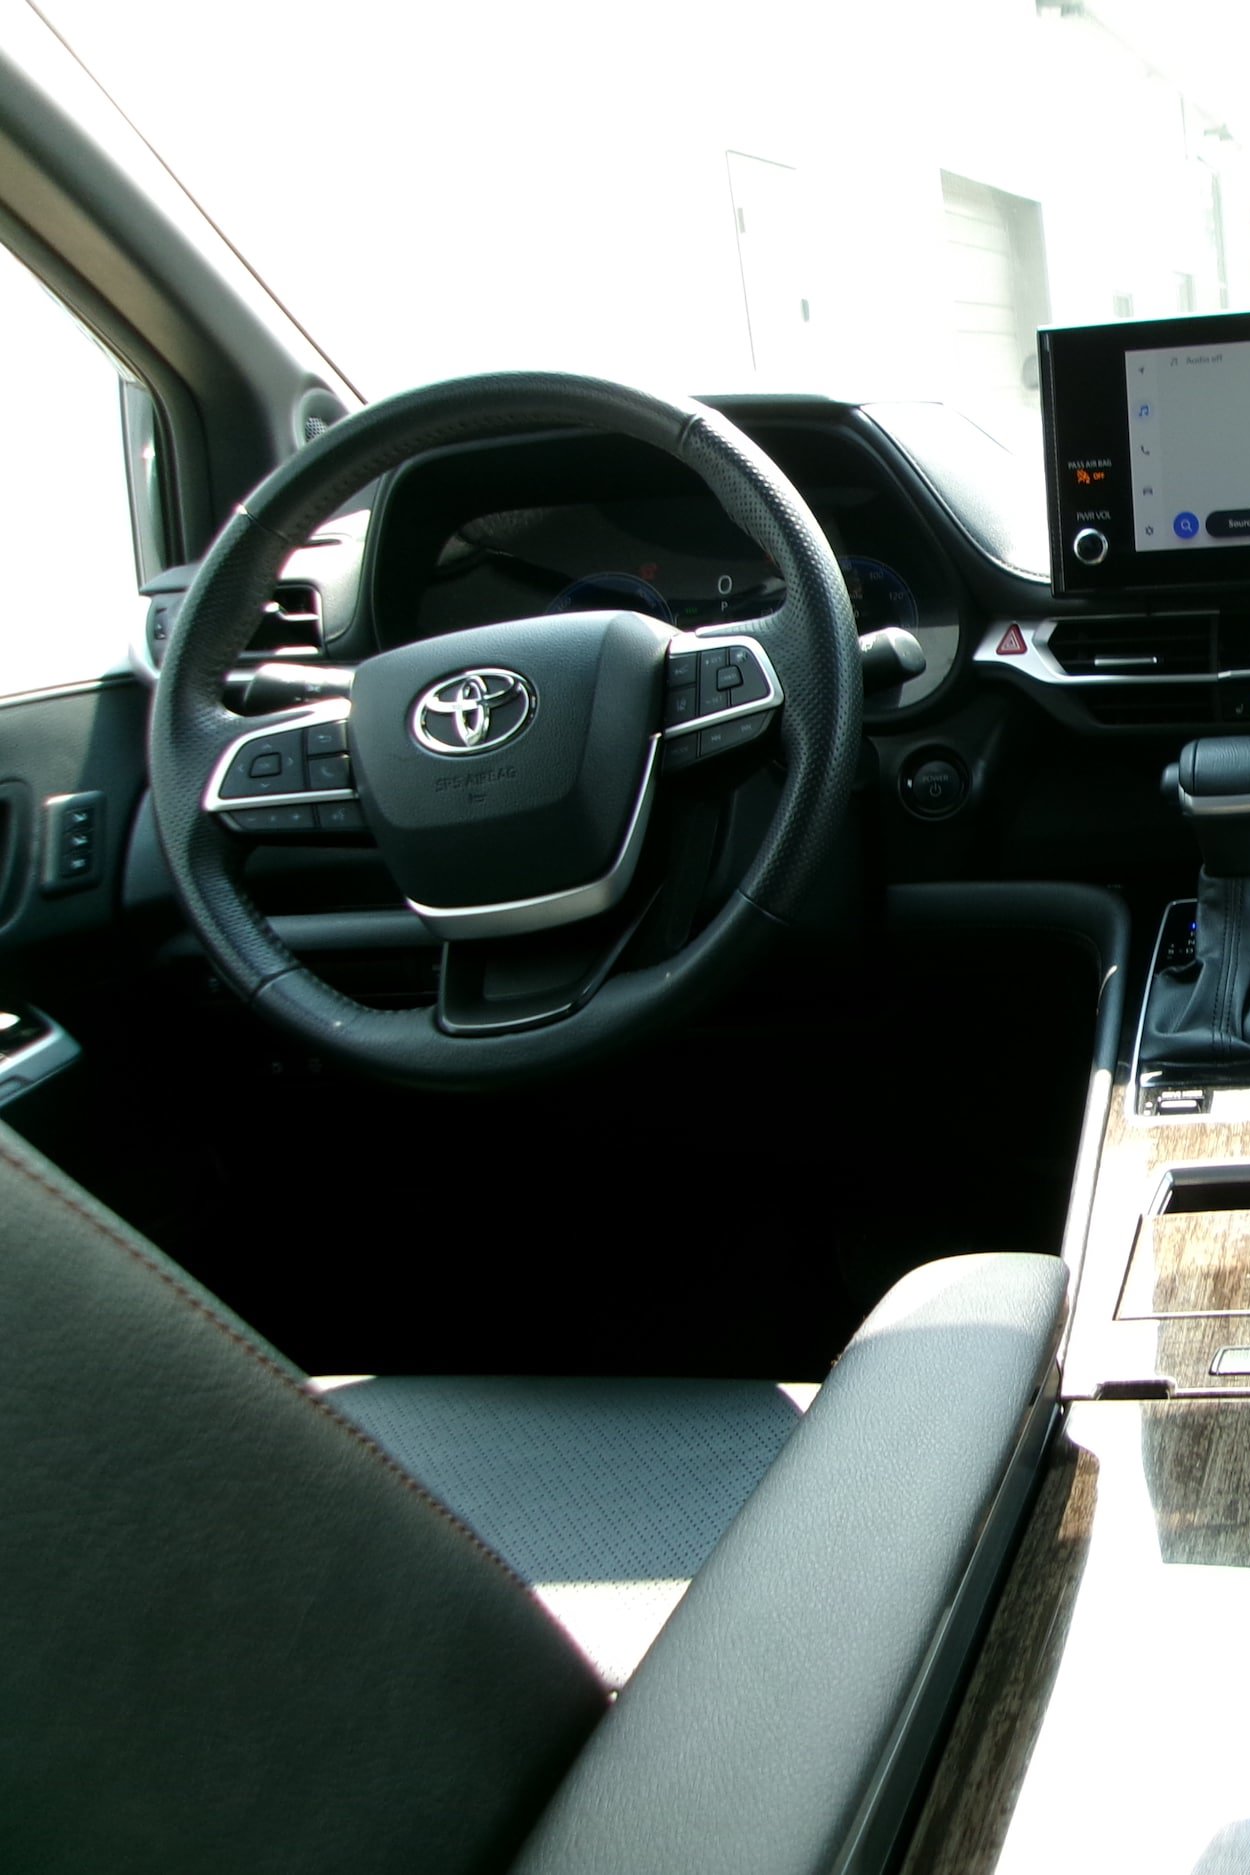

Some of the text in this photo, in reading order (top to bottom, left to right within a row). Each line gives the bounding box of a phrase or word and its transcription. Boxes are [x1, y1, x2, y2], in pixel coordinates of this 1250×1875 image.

[1186, 356, 1209, 366] Audio
[1068, 458, 1112, 470] PASS AIR BAG
[1076, 510, 1112, 521] PWR VOL
